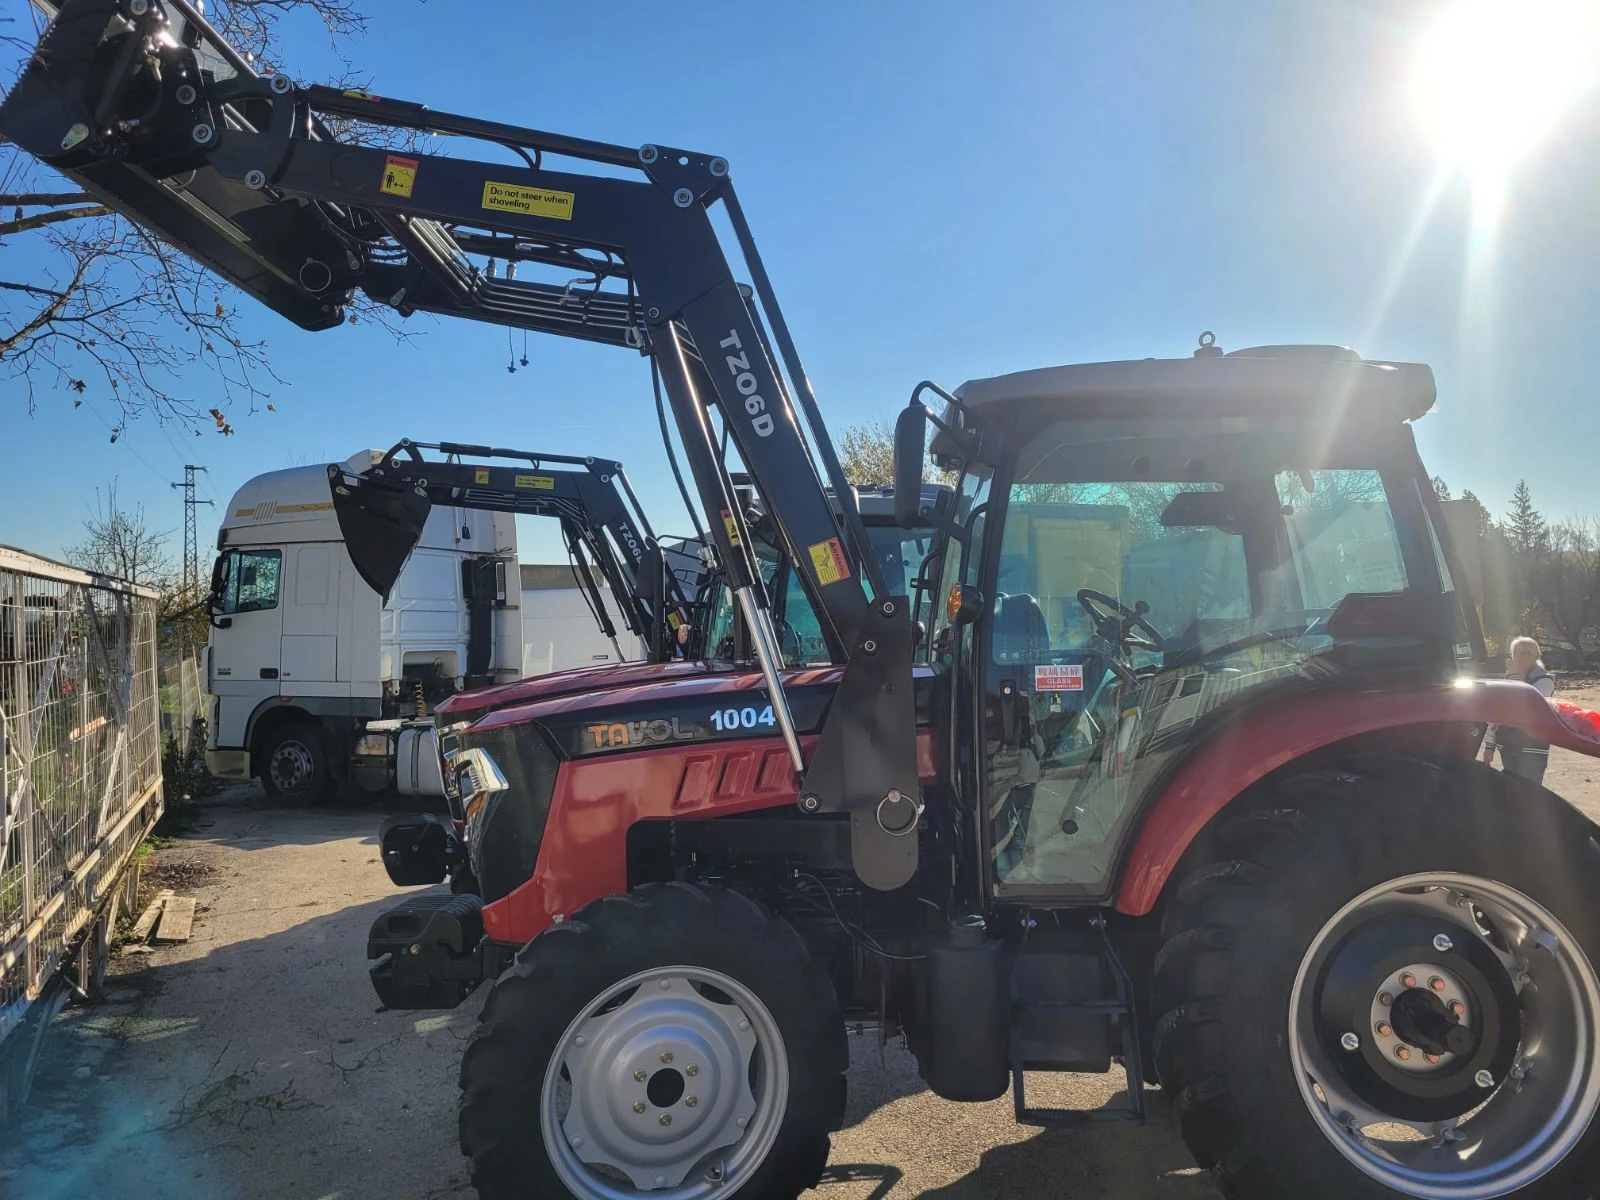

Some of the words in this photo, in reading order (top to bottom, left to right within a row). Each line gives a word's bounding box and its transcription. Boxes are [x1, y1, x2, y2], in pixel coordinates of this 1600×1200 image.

[488, 197, 530, 210] shoveling
[490, 186, 502, 196] Do
[504, 190, 519, 198] not
[520, 192, 542, 201] steer
[544, 194, 569, 205] when
[710, 705, 776, 731] 1004
